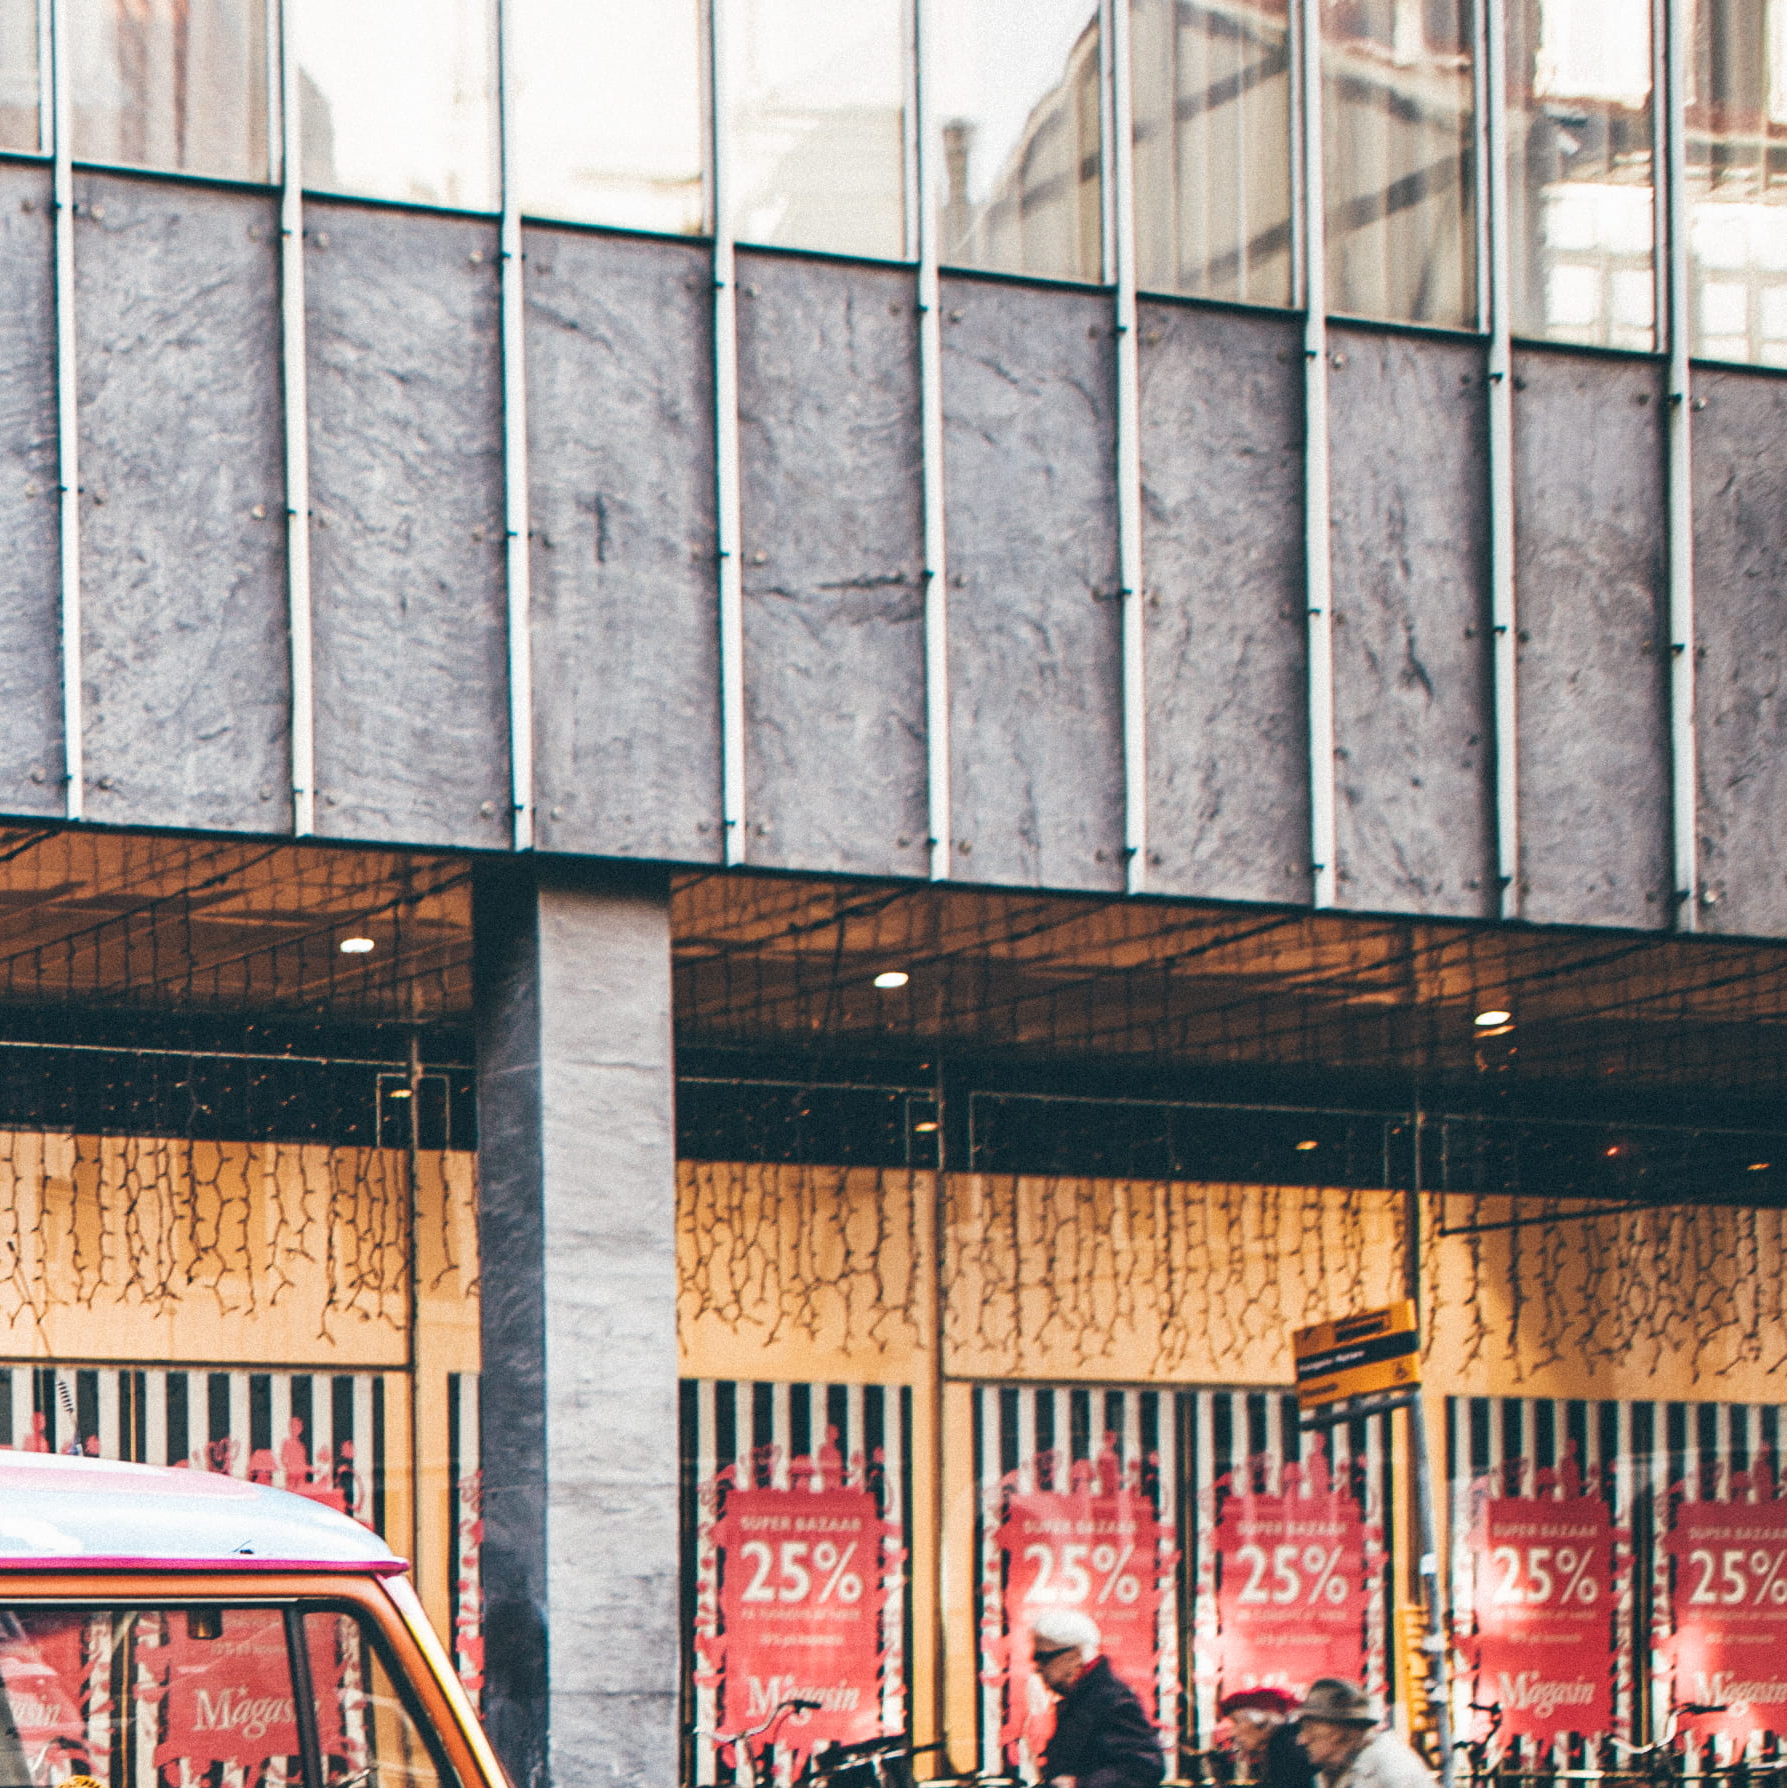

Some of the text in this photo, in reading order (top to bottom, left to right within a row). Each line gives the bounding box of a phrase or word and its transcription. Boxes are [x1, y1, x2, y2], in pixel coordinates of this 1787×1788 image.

[740, 1539, 864, 1604] 25%
[1023, 1542, 1141, 1605] 25%
[1236, 1542, 1350, 1606] 25%
[1492, 1545, 1600, 1605] 25%
[1688, 1547, 1787, 1606] 25%
[1497, 1670, 1596, 1719] Magasin
